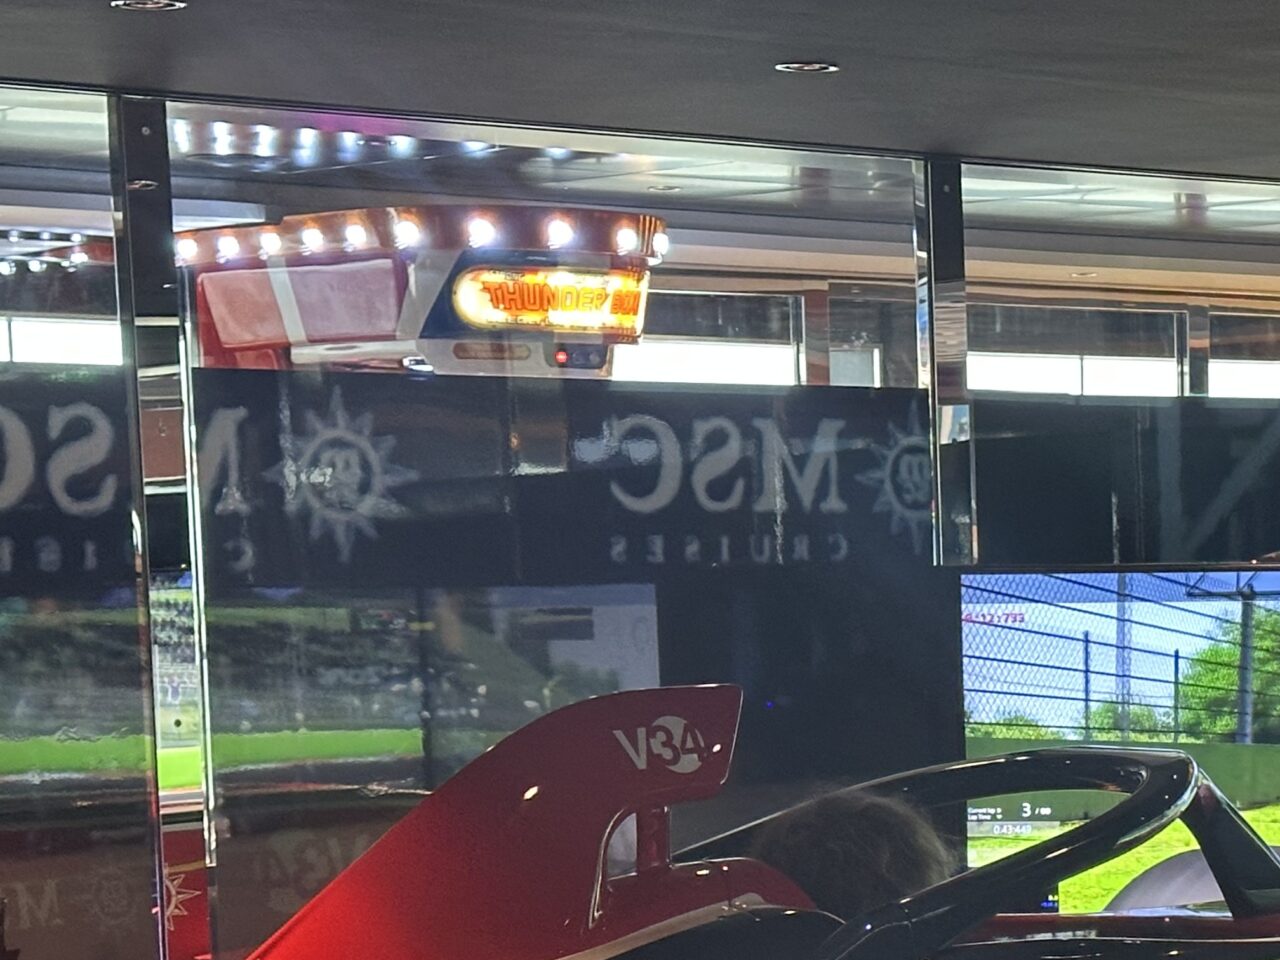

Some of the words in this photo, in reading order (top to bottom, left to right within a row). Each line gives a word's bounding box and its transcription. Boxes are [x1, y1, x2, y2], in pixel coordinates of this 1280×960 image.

[483, 281, 609, 312] THUNDER
[612, 715, 706, 774] V34
[1022, 803, 1031, 817] 3
